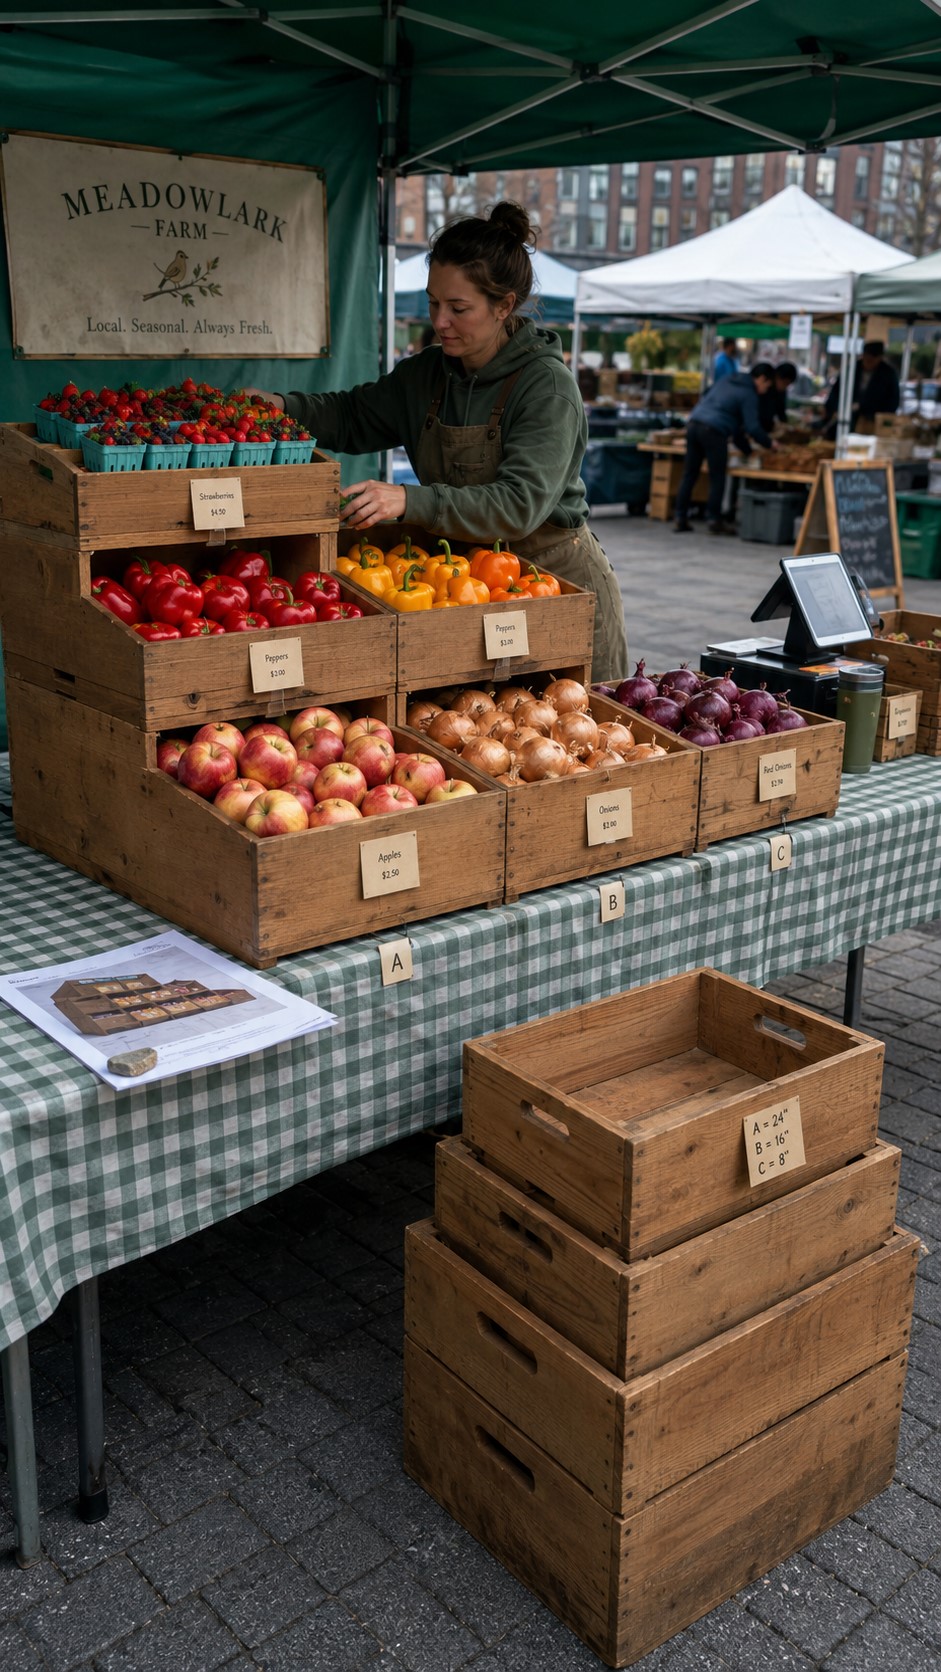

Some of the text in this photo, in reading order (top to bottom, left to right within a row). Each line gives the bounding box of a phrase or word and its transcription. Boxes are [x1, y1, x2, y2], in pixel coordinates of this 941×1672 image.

[61, 181, 288, 243] MEADOWLARK
[155, 219, 207, 239] FARM
[87, 317, 273, 338] Local. Seasonal. Always Fresh.
[495, 624, 516, 634] Peppers
[265, 653, 289, 664] Peppers
[763, 762, 792, 775] Red Onions
[598, 804, 620, 815] Onions
[378, 850, 402, 864] Apples
[777, 845, 785, 861] C
[381, 868, 400, 880] $2.50
[609, 894, 618, 911] B
[391, 952, 404, 973] A
[752, 1121, 761, 1136] A
[771, 1108, 788, 1128] 24"
[755, 1141, 763, 1155] B
[775, 1129, 789, 1146] 16"
[758, 1161, 766, 1175] C
[778, 1150, 789, 1166] 8"
